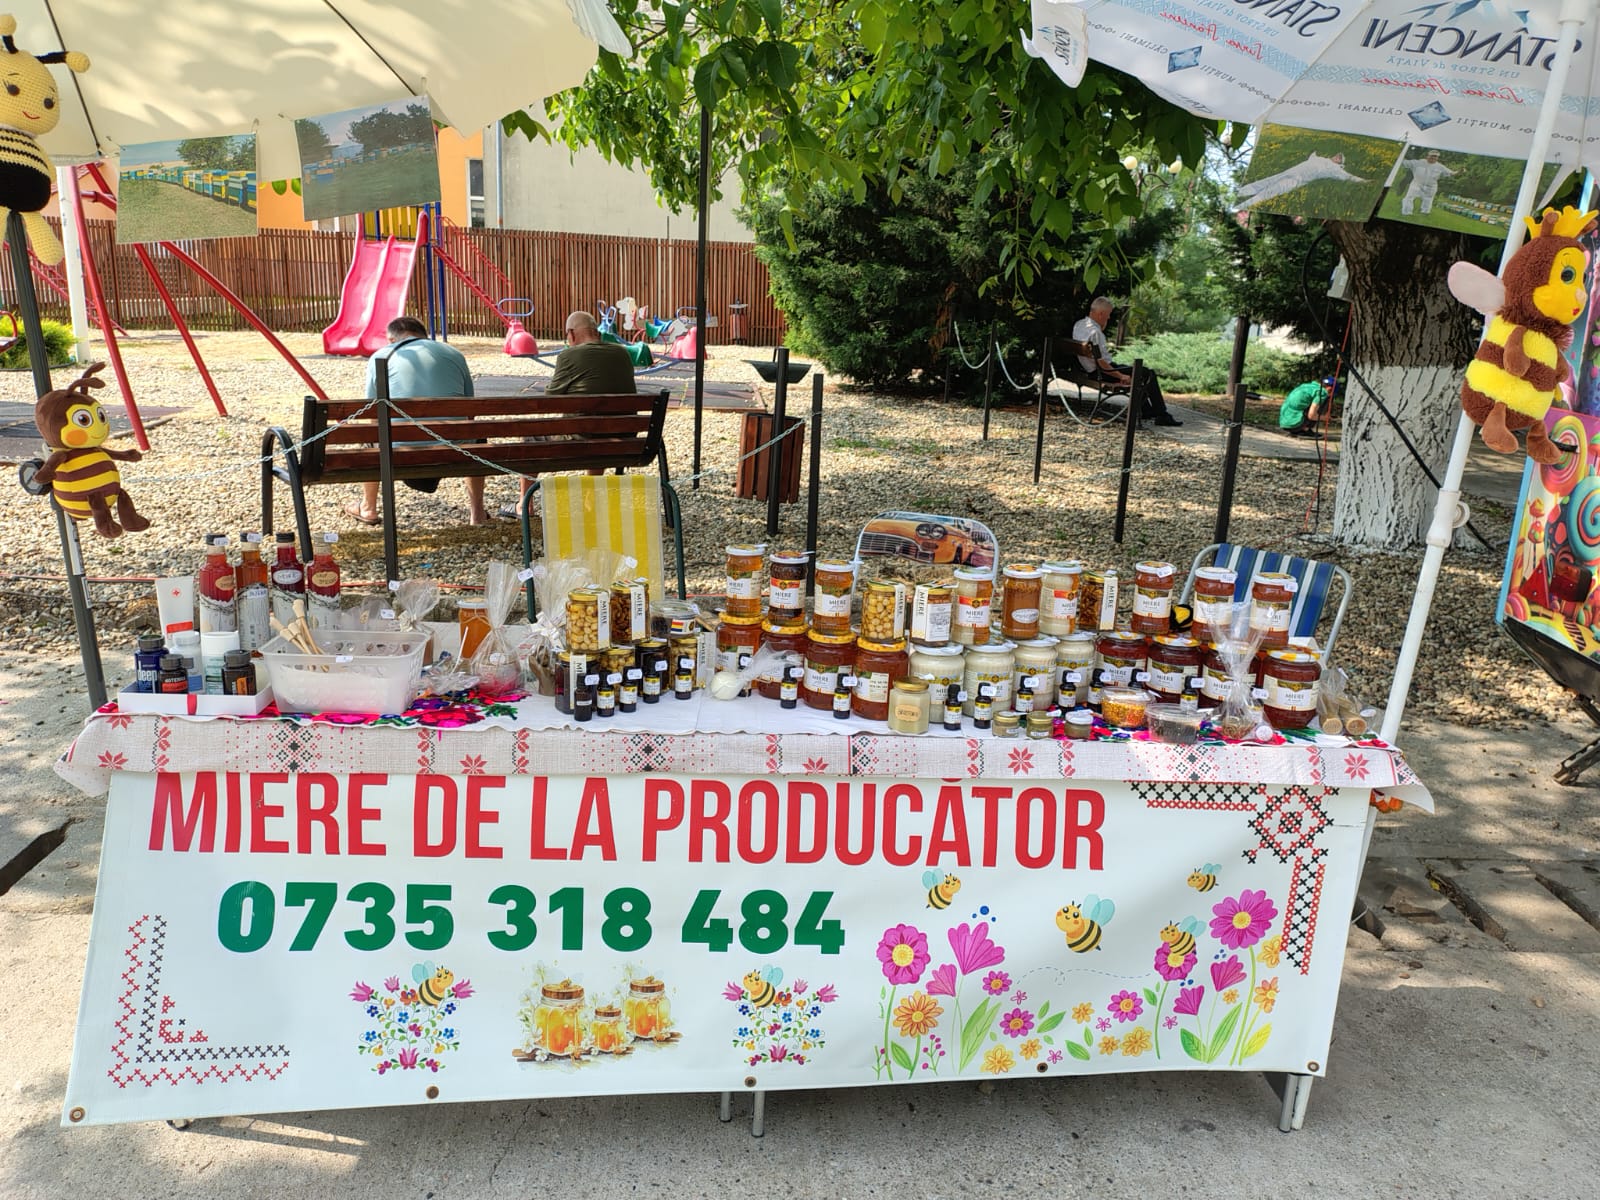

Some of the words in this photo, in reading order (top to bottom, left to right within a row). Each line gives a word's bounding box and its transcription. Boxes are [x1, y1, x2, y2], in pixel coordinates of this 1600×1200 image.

[148, 771, 389, 856] MIERE
[413, 773, 507, 860] DE
[530, 776, 618, 862] LA
[218, 880, 454, 953] 0735
[487, 884, 653, 953] 318
[681, 889, 846, 955] 484
